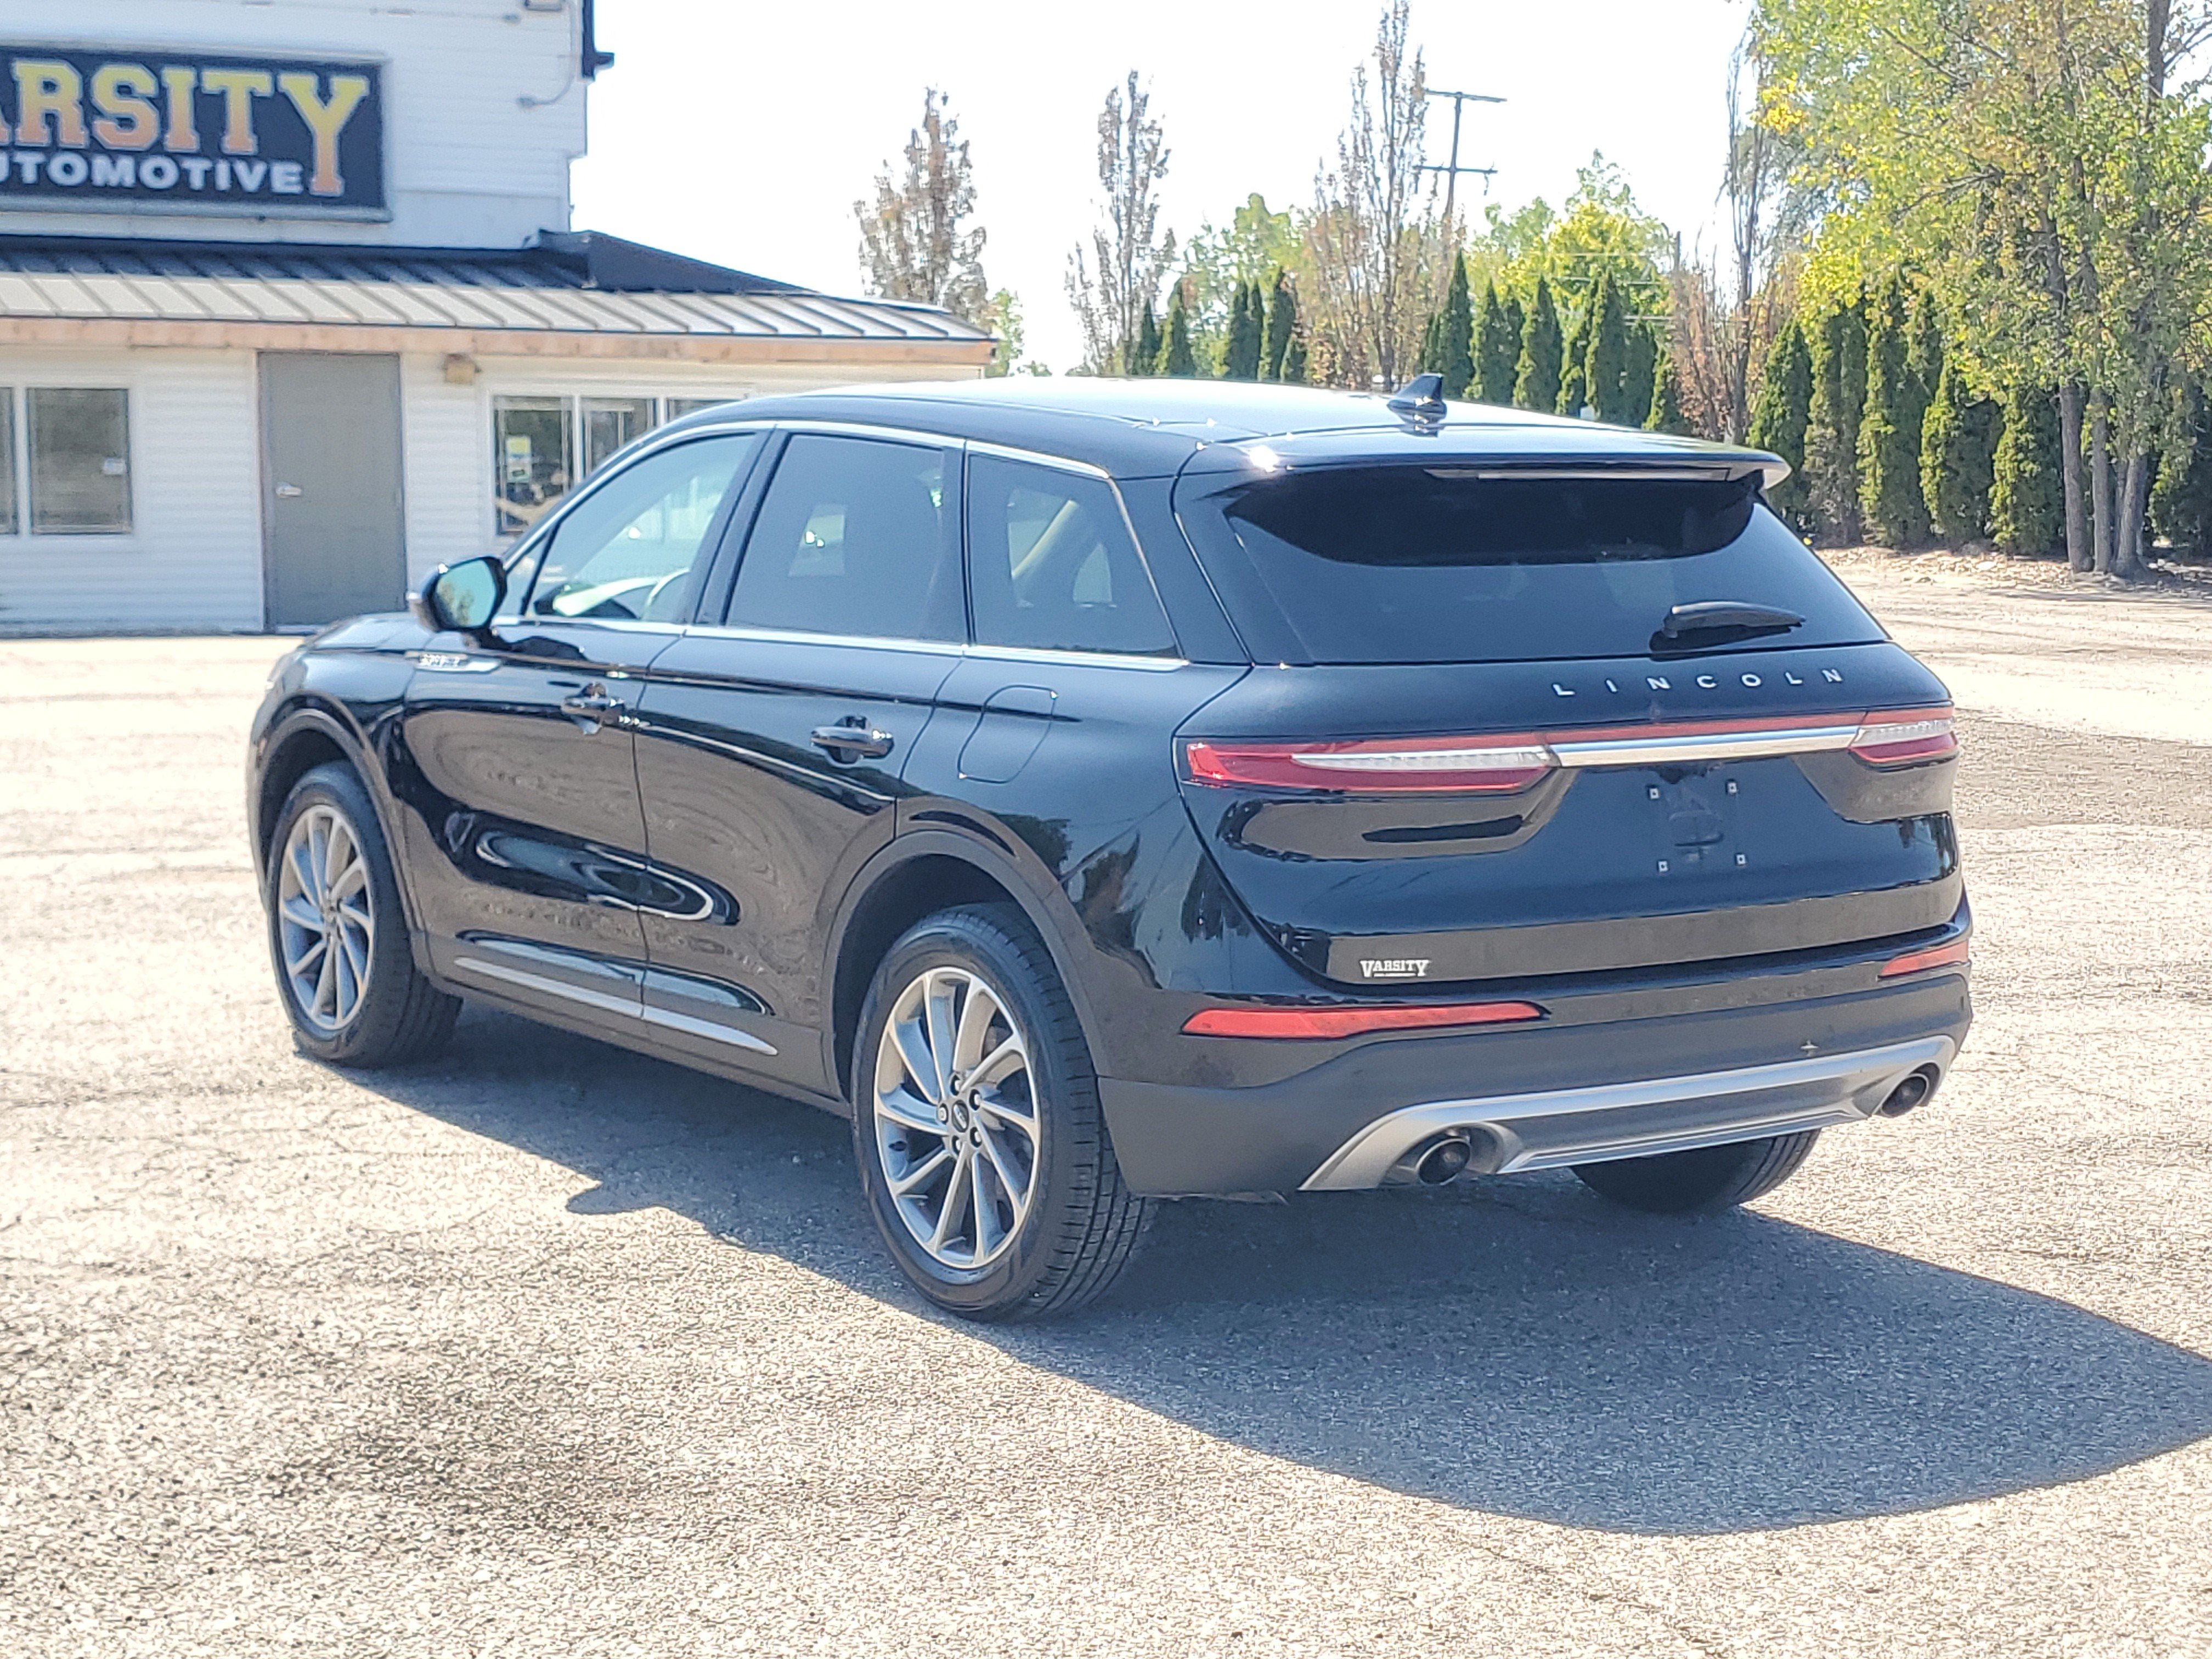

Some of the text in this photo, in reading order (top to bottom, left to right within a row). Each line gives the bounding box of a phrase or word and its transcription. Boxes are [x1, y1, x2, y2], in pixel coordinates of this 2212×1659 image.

[0, 59, 369, 196] RSITY
[0, 150, 304, 194] TOMOTIVE
[1552, 669, 1843, 696] LINCOLN
[1360, 960, 1430, 978] VARSITY
